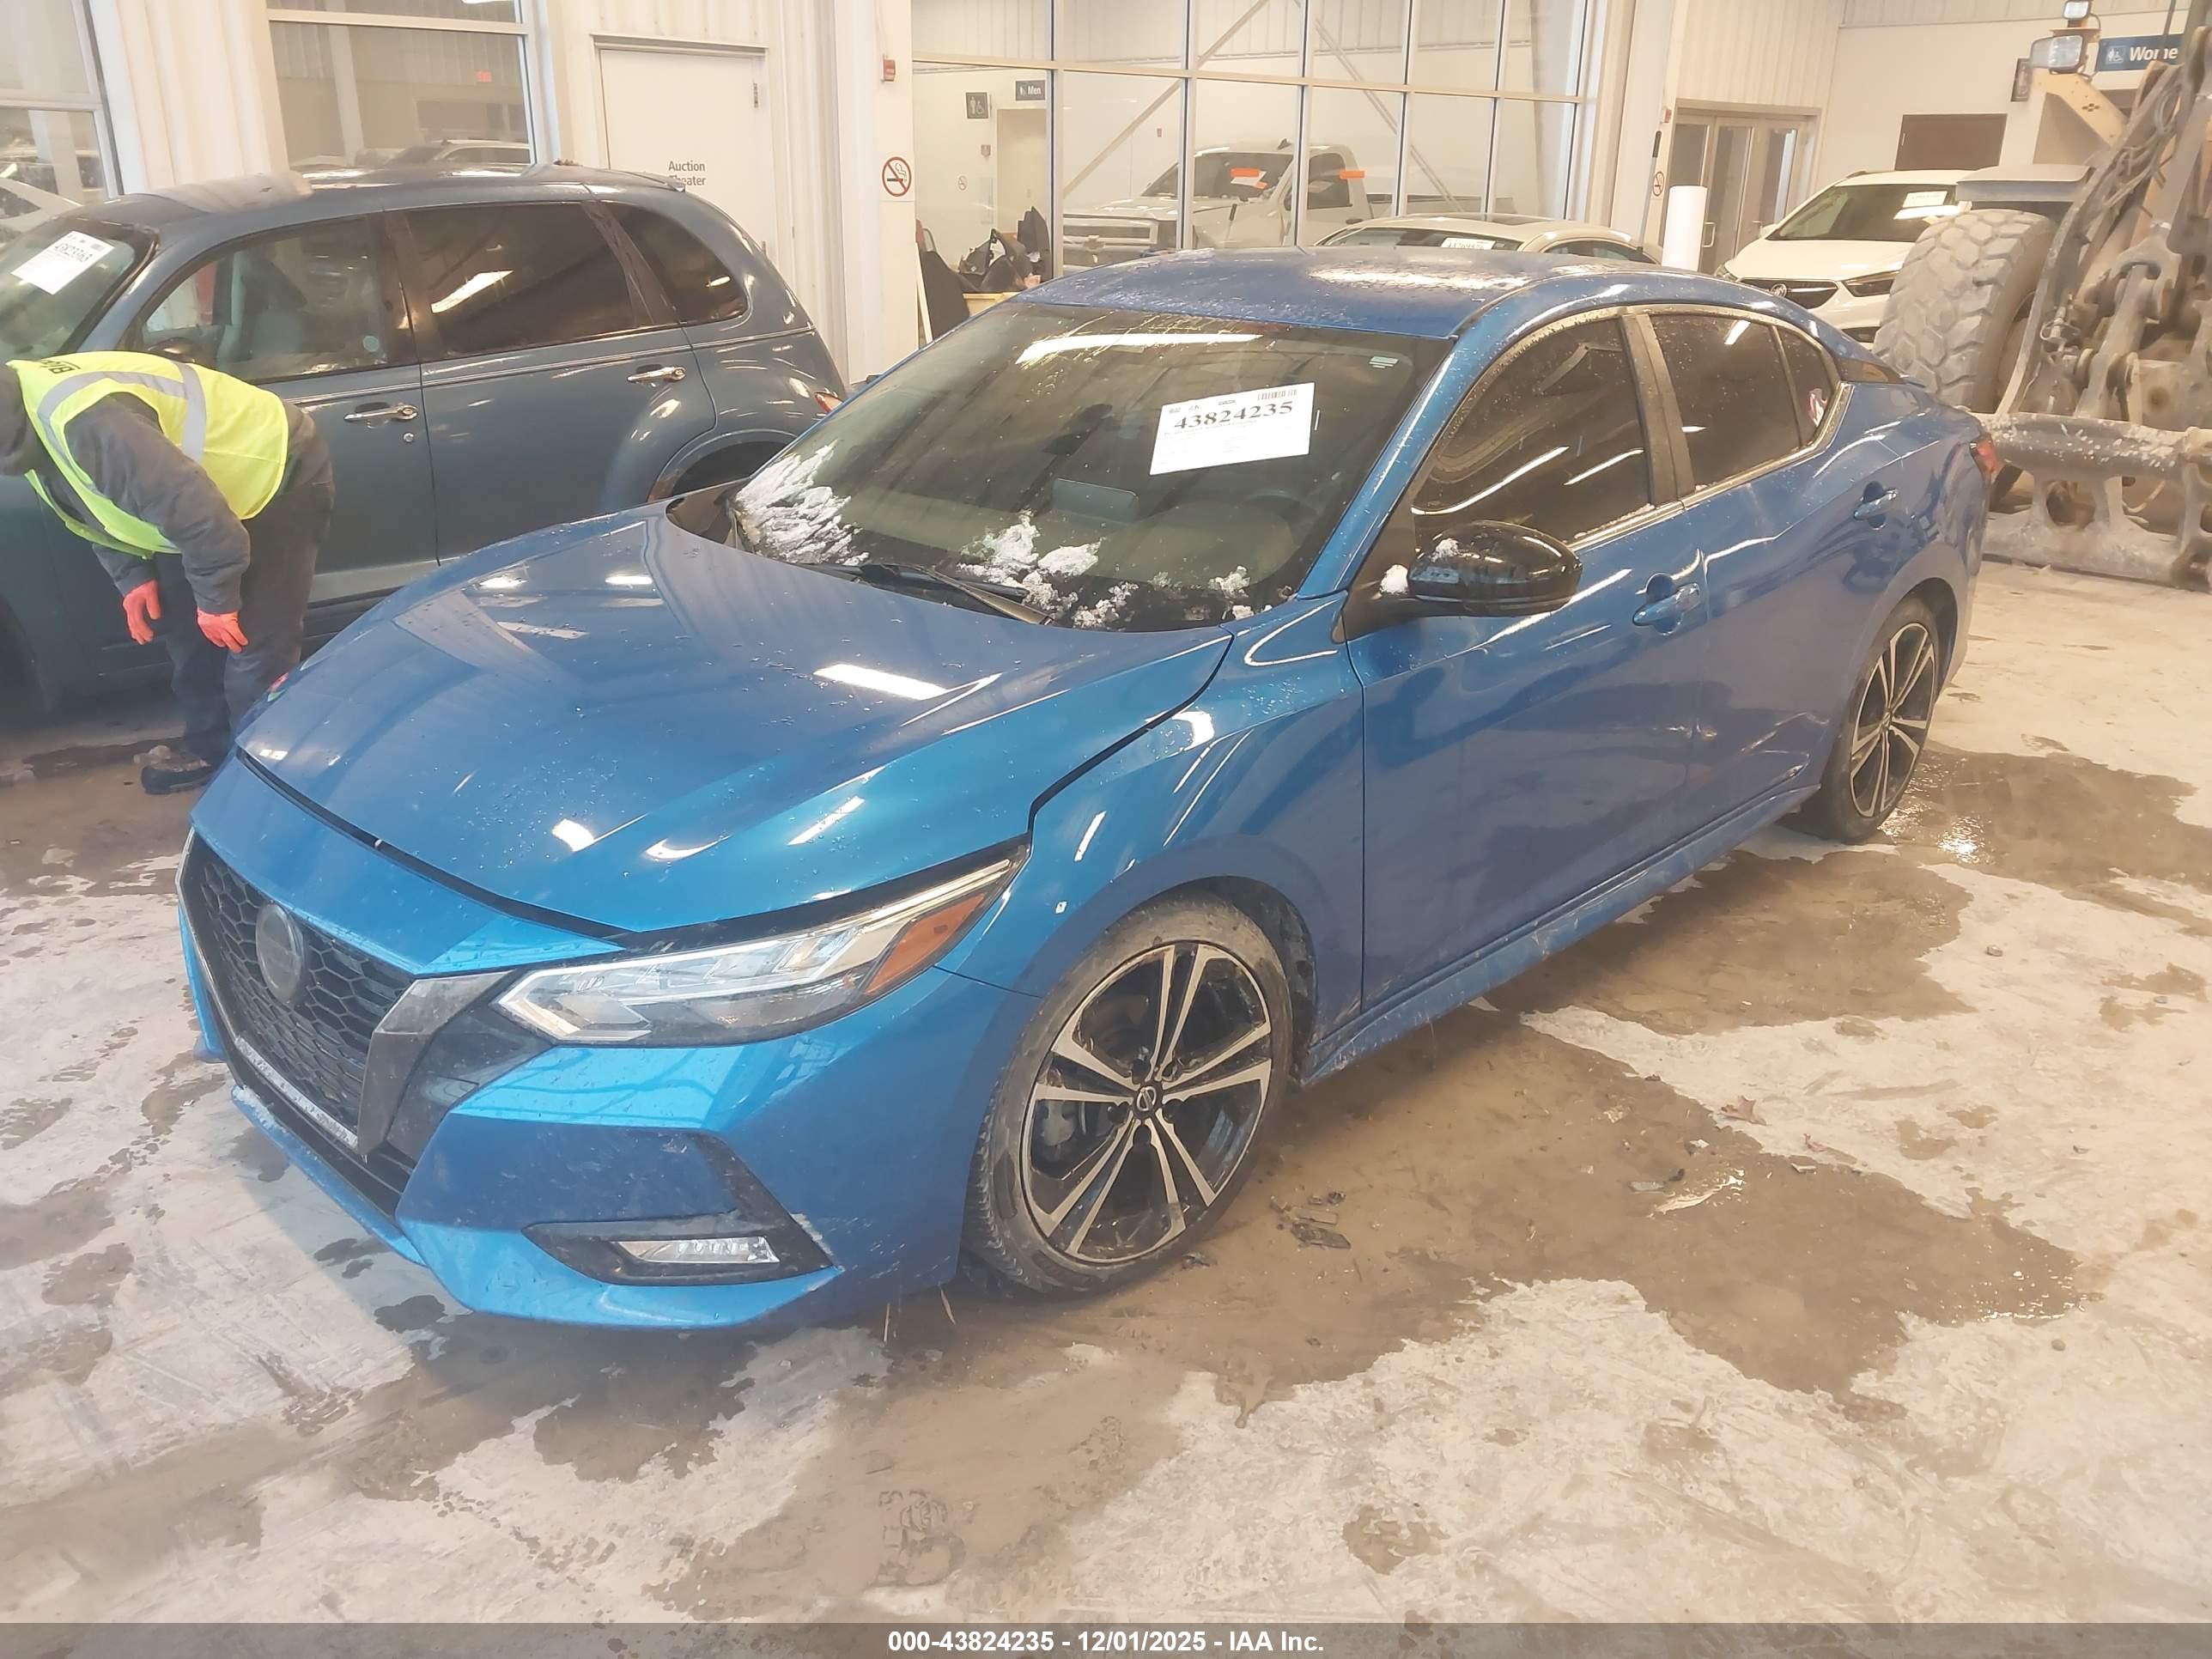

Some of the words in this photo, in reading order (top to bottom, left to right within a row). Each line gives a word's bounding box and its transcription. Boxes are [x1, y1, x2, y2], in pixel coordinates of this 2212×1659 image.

[2130, 46, 2179, 61] Wome
[1027, 85, 1042, 95] Men
[668, 160, 706, 172] Auction
[669, 174, 707, 186] eater
[1174, 401, 1293, 429] 43824235
